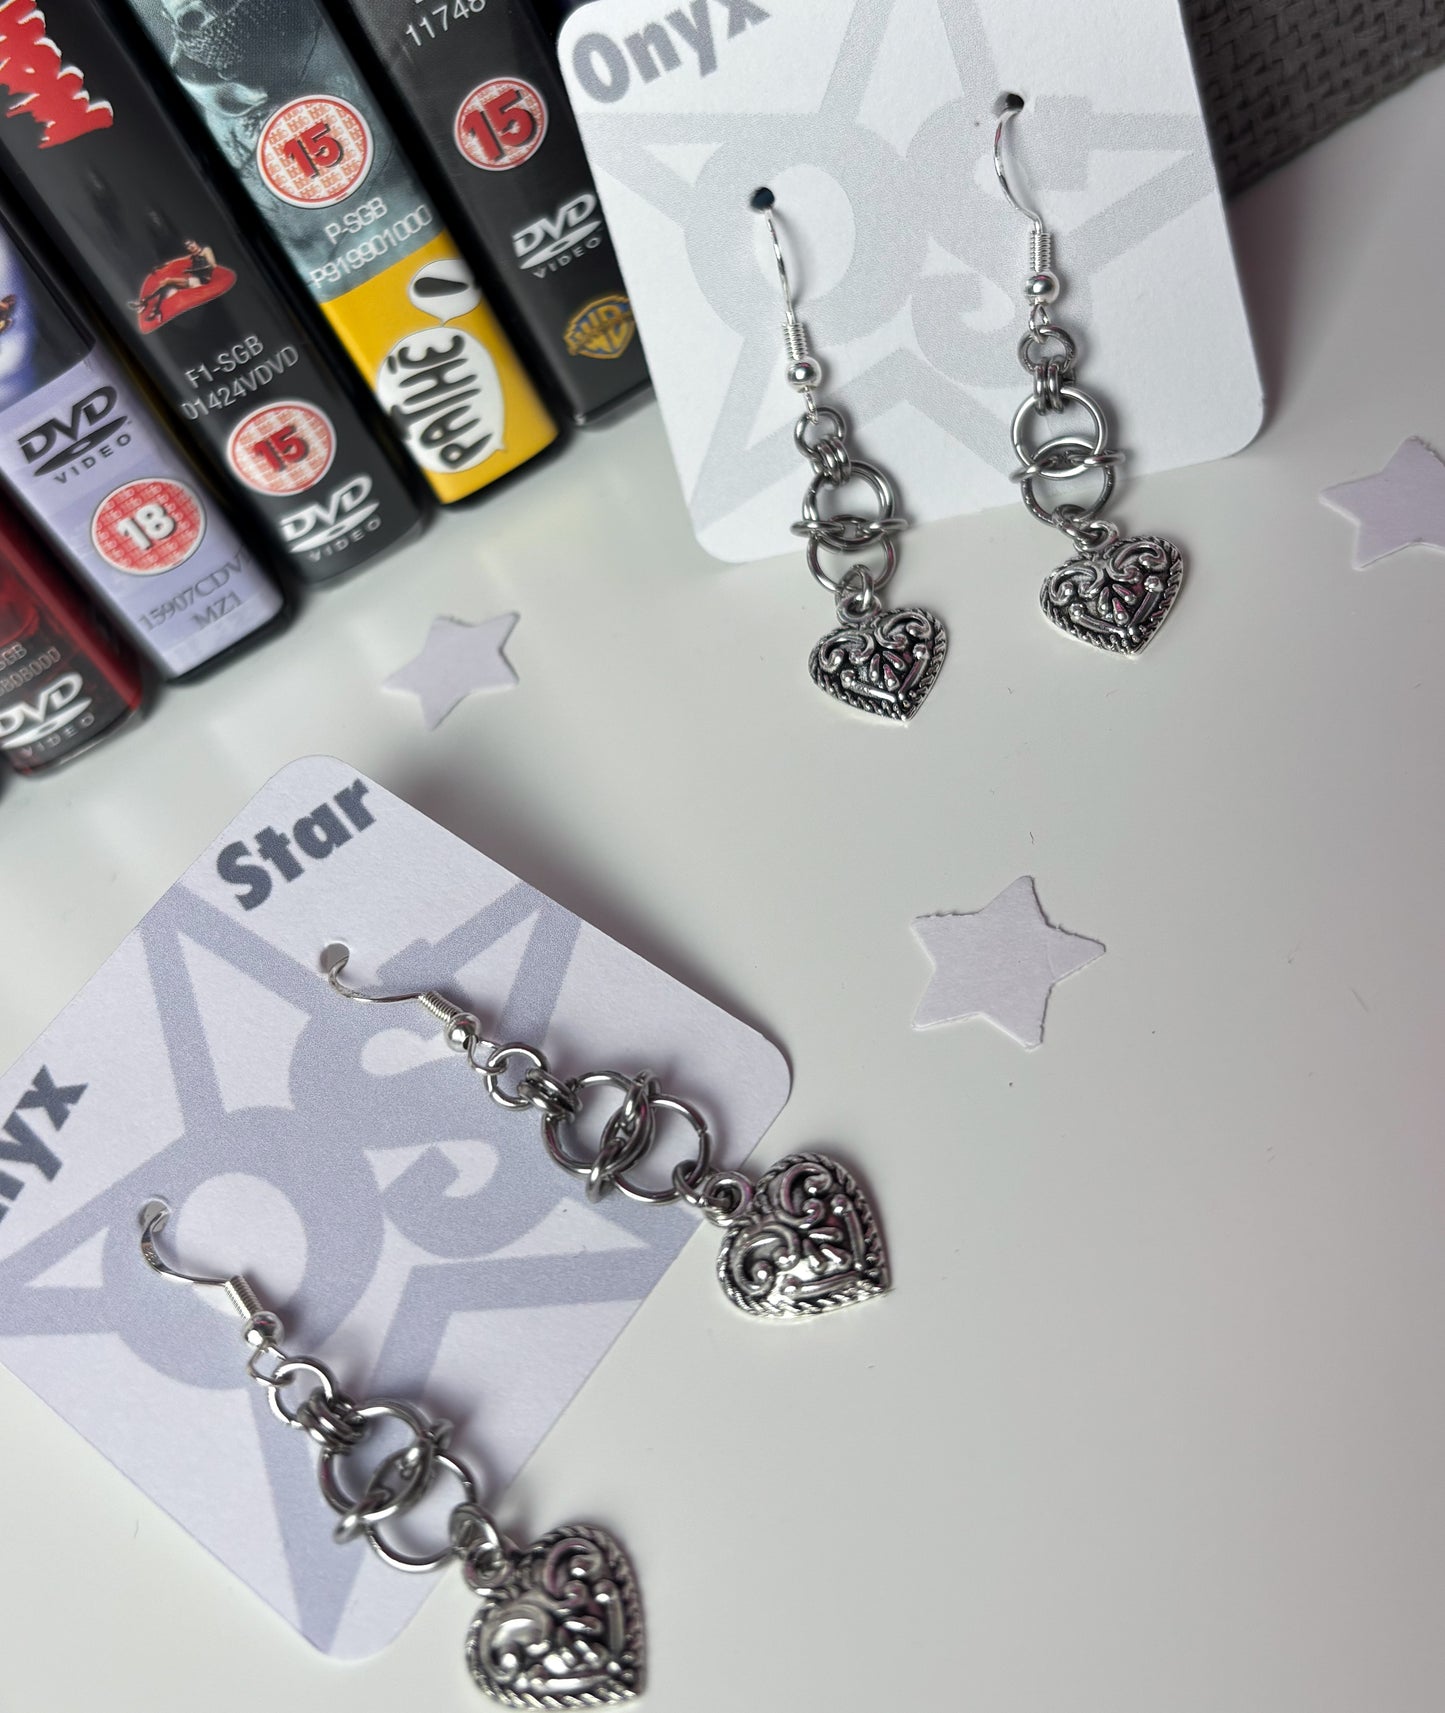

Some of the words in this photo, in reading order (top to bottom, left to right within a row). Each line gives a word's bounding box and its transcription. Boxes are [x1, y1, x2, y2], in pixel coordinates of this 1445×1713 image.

[572, 0, 771, 104] Onyx
[283, 121, 345, 180] 15
[463, 88, 537, 163] 15
[309, 204, 433, 289] P919901000
[324, 196, 388, 245] P-SGB
[512, 193, 596, 258] DVD
[532, 236, 602, 279] VIDEO
[180, 345, 299, 420] 01424VDVD
[184, 335, 265, 388] F1-SGB
[17, 385, 118, 464] DVD
[253, 424, 310, 473] 15
[53, 433, 131, 484] VIDEO
[116, 503, 176, 550] 18
[280, 474, 373, 541] DVD
[308, 516, 382, 562] VIDEO
[0, 671, 83, 738] DVD
[21, 711, 95, 757] VIDEO
[216, 778, 377, 912] Star
